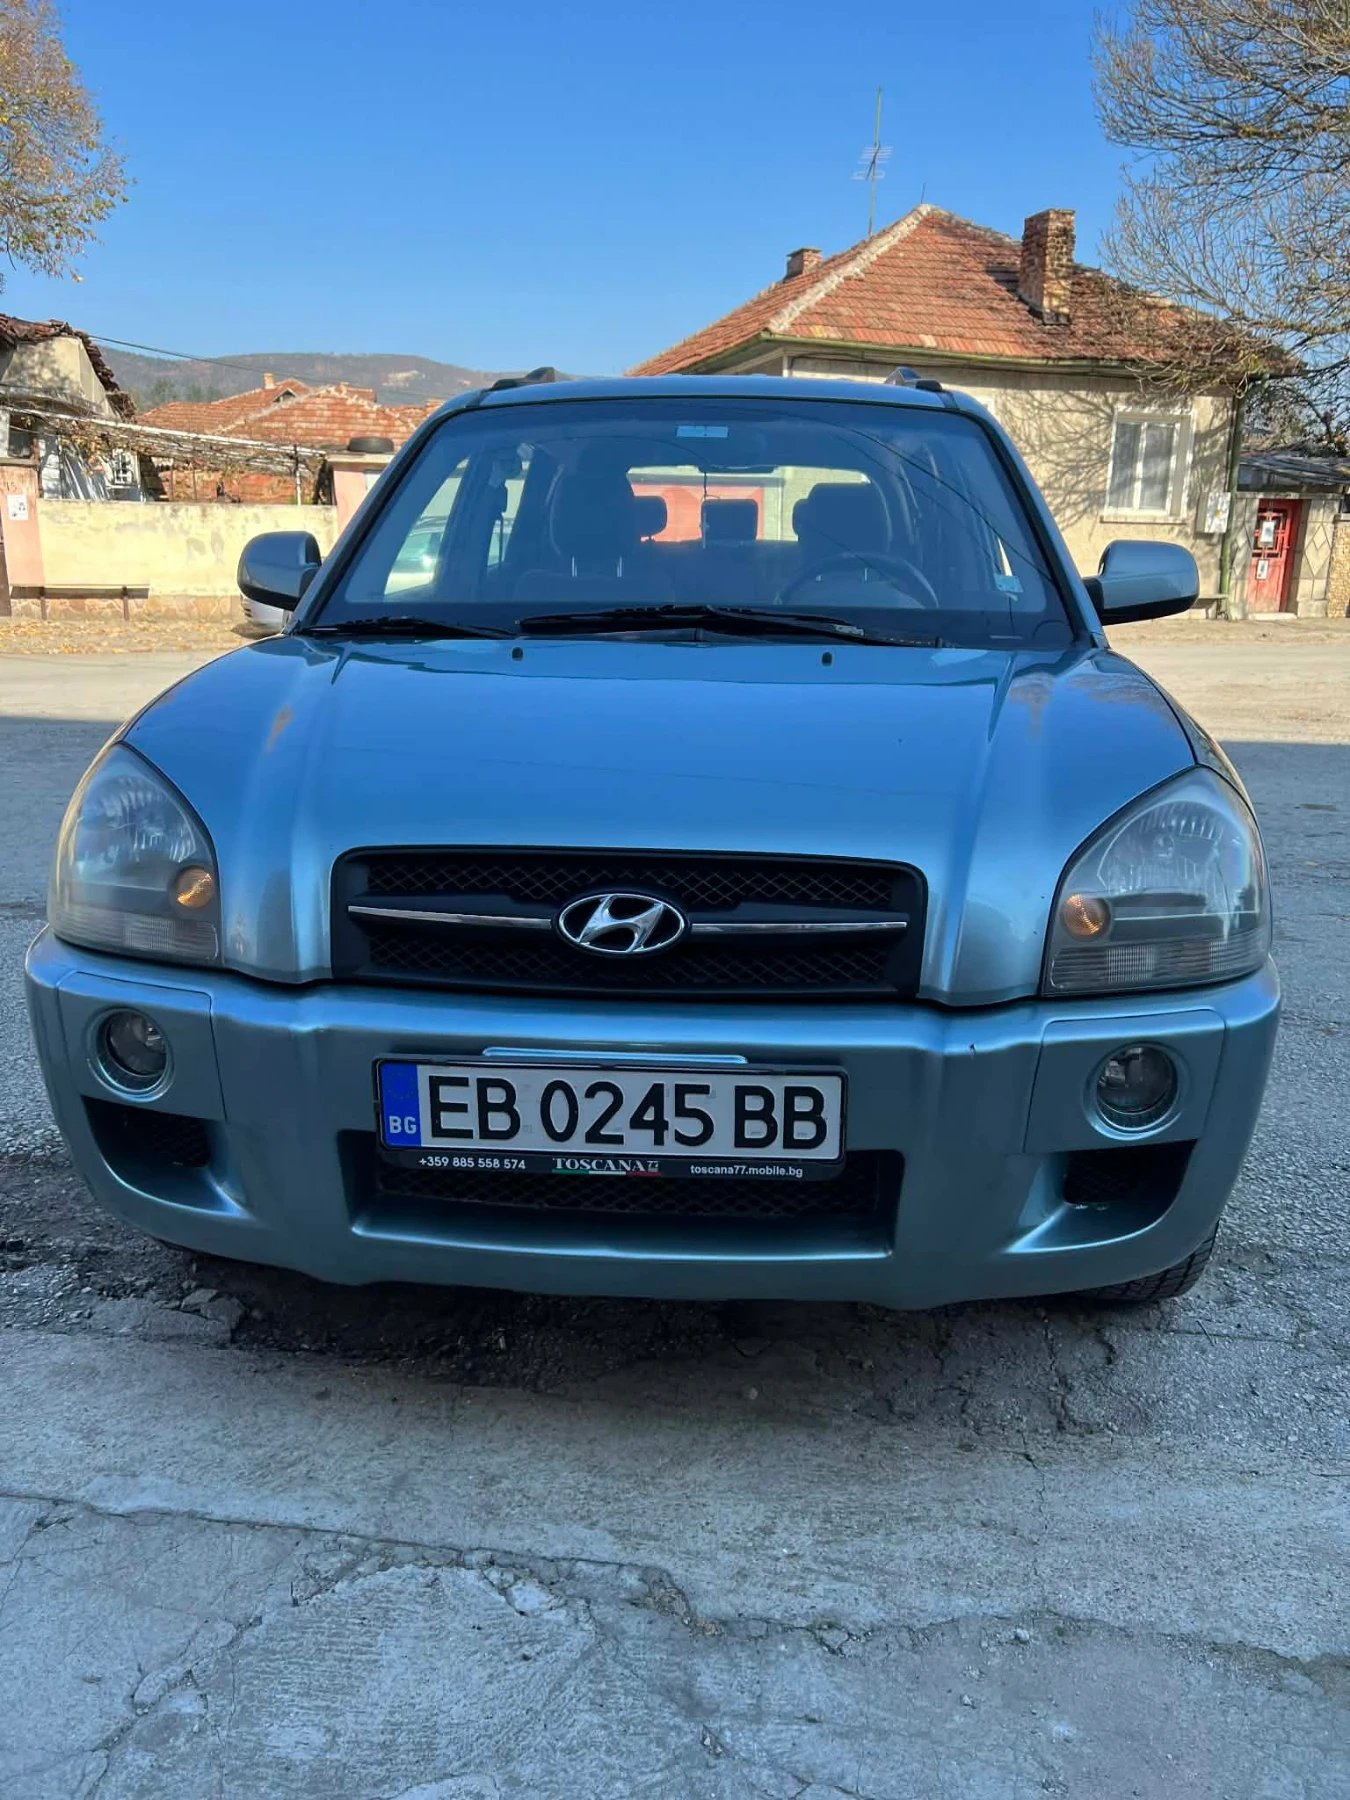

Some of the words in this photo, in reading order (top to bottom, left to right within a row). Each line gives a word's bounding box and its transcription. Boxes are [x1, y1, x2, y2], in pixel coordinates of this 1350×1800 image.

[428, 1075, 521, 1141] EB
[540, 1079, 715, 1147] 0245
[733, 1085, 828, 1150] BB
[388, 1115, 418, 1135] BG
[419, 1156, 449, 1167] +359
[452, 1157, 475, 1168] 885
[477, 1158, 501, 1169] 558
[503, 1159, 527, 1170] 574
[552, 1157, 647, 1172] TOSCANA
[690, 1164, 804, 1178] toscana77.mobile.bg
